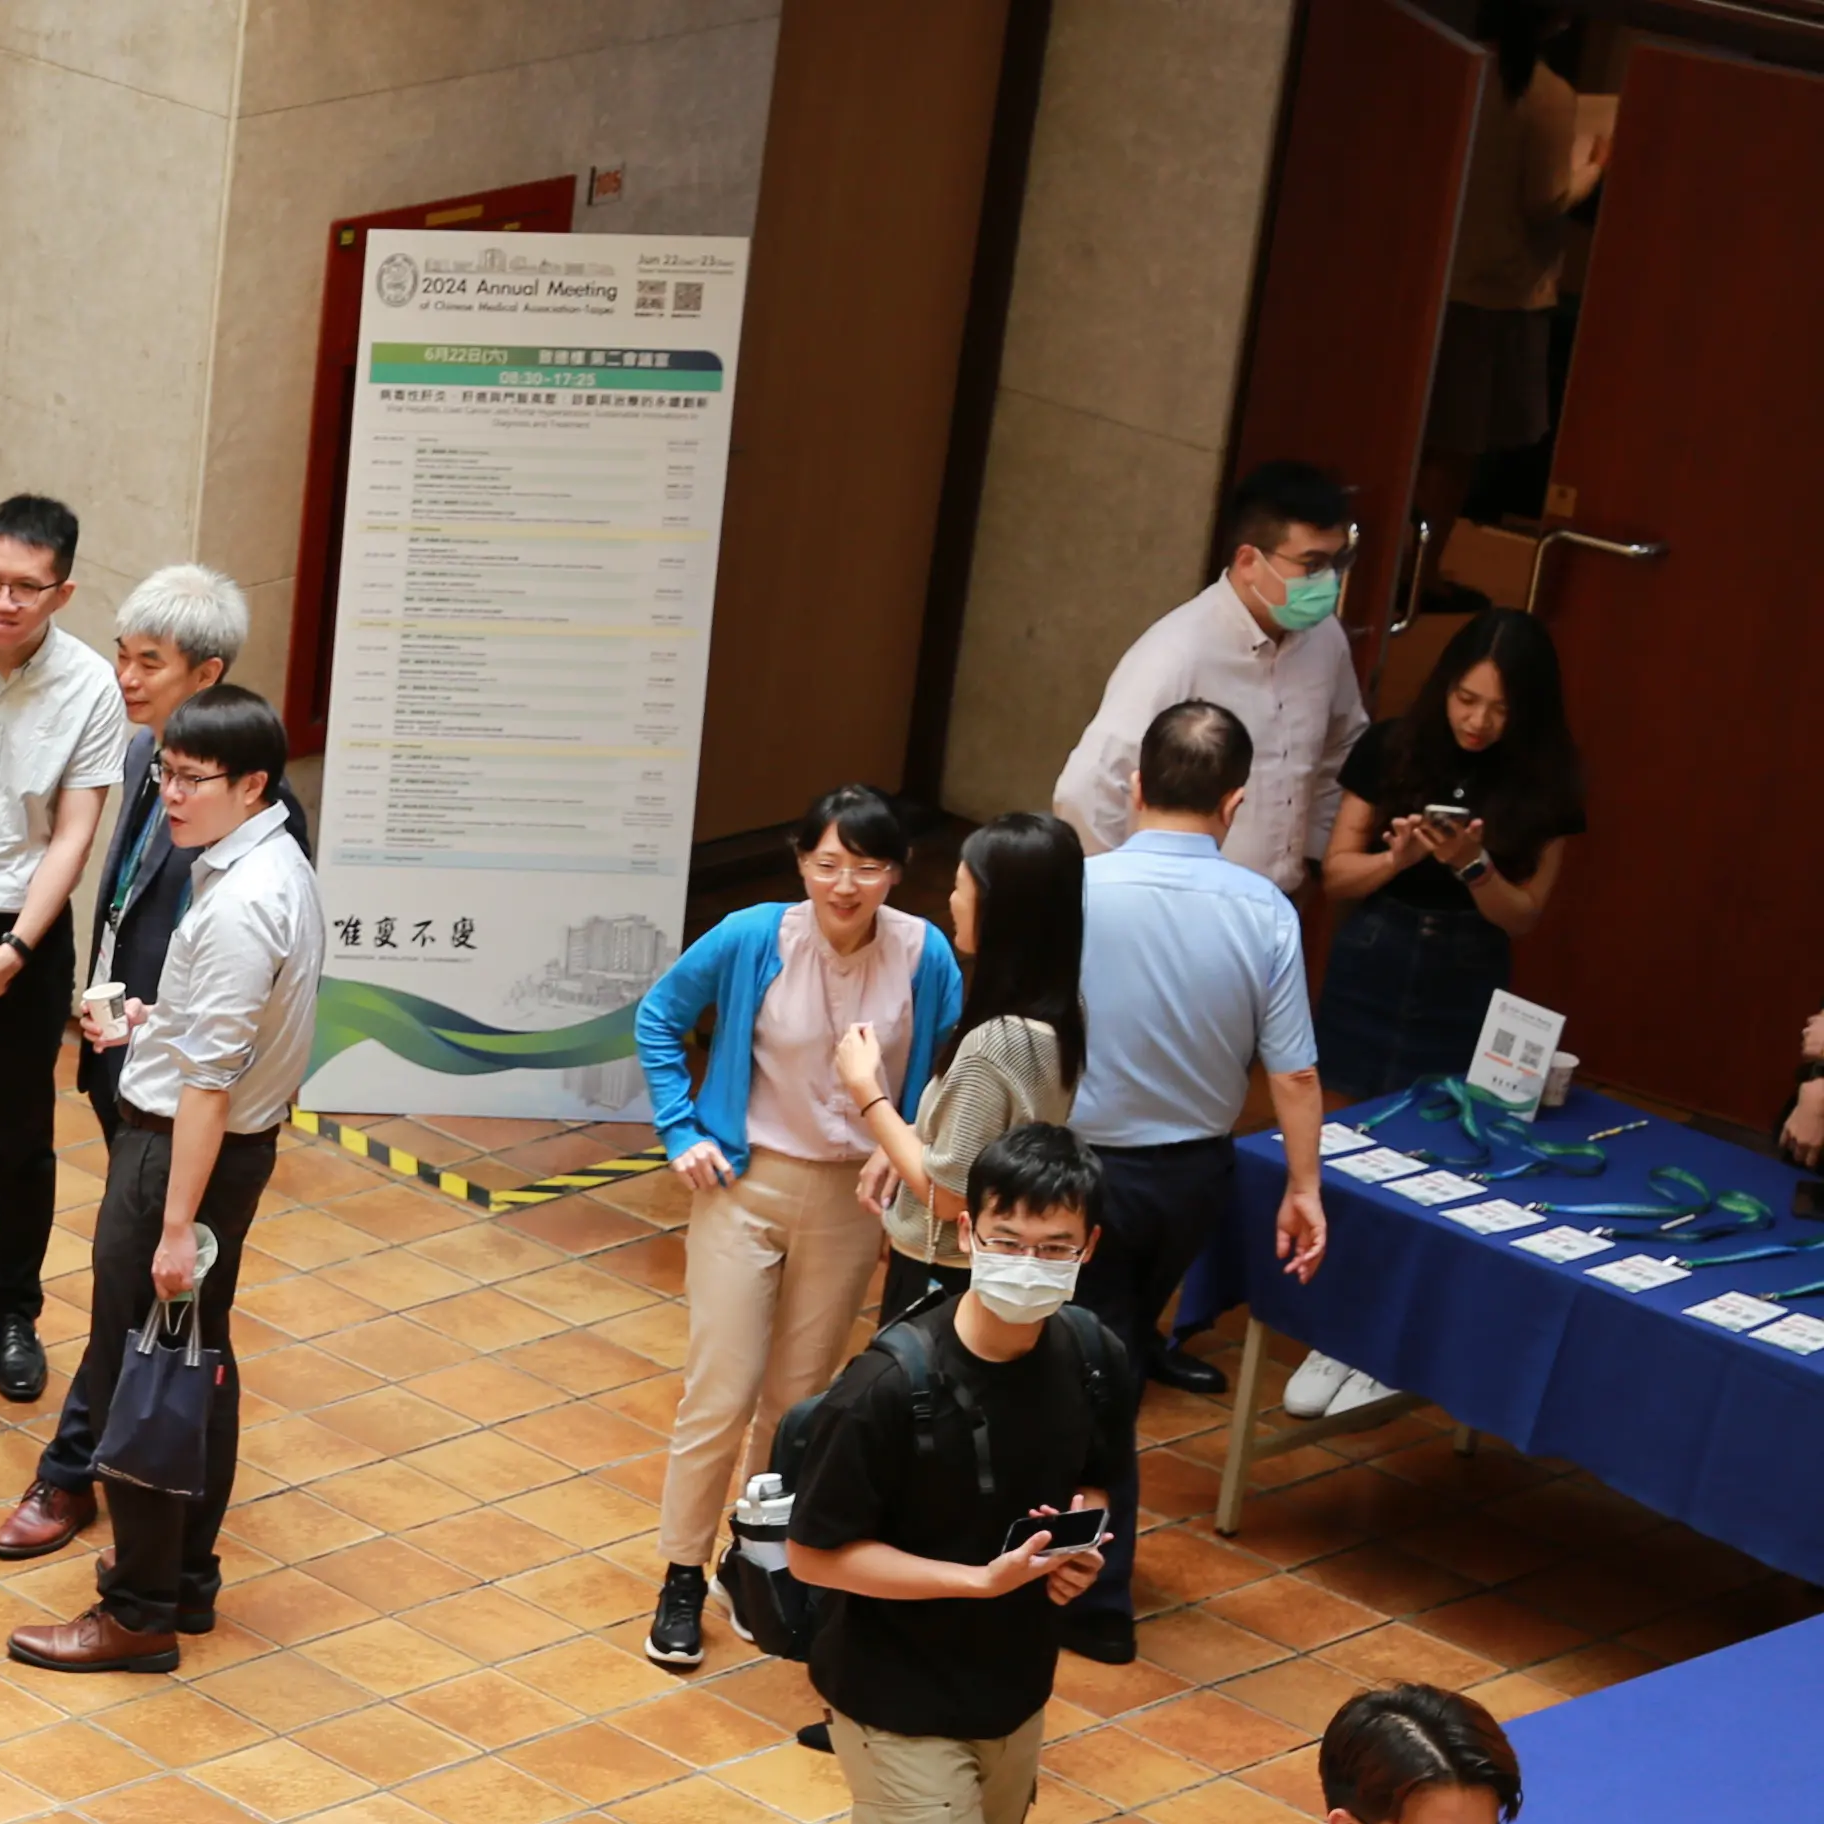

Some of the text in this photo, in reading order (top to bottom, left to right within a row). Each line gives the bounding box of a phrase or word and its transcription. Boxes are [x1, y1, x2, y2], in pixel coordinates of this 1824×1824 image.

[422, 277, 618, 301] 2024 Annual Meeting
